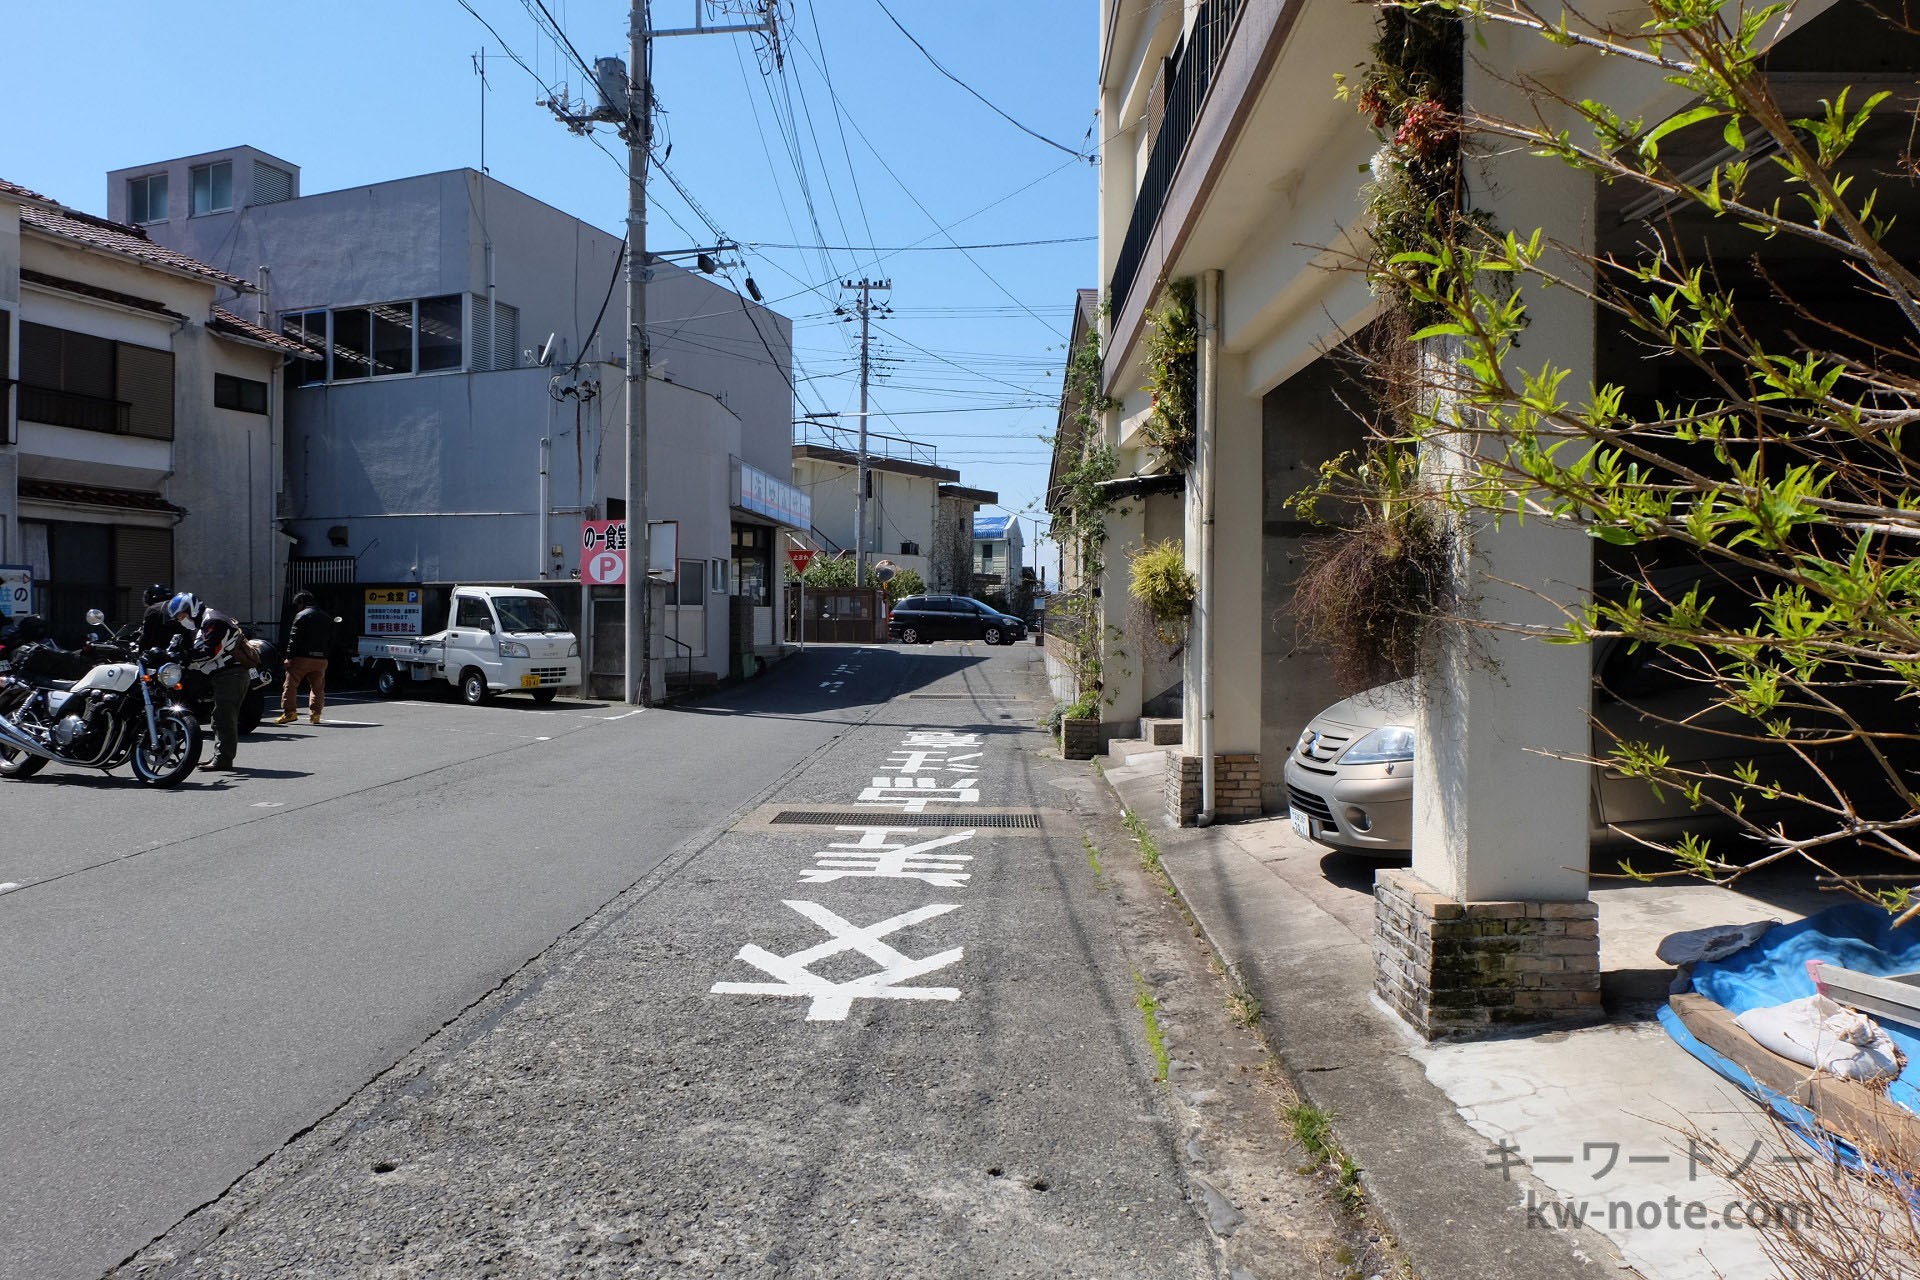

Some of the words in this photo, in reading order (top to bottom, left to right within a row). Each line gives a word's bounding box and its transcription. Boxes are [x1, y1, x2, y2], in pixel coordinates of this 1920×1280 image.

[599, 556, 617, 581] P
[368, 591, 404, 602] の一食堂
[408, 591, 417, 602] P
[370, 622, 416, 633] 無断駐車禁止
